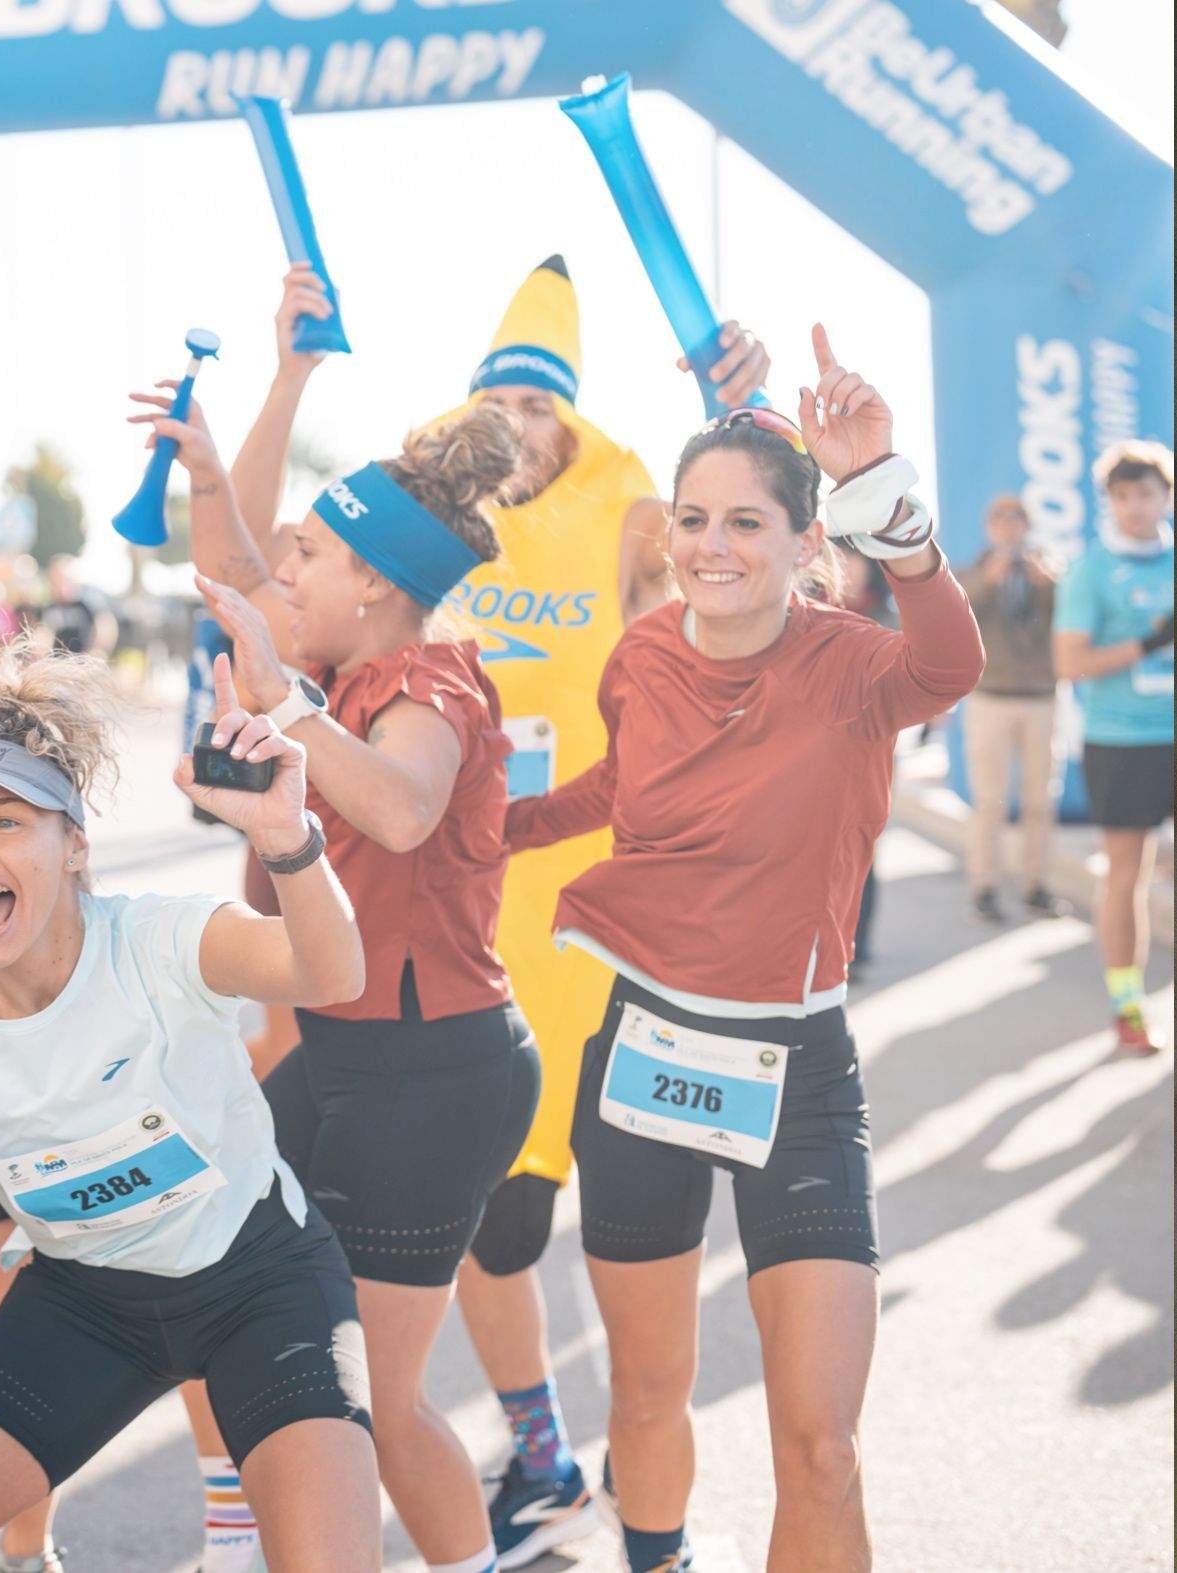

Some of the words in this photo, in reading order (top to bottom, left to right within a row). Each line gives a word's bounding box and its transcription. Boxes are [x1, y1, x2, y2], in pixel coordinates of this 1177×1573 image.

[156, 44, 311, 119] RUN
[315, 27, 546, 106] HAPPY
[802, 40, 1035, 235] Running
[652, 1072, 723, 1114] 2376
[70, 1166, 153, 1212] 2384
